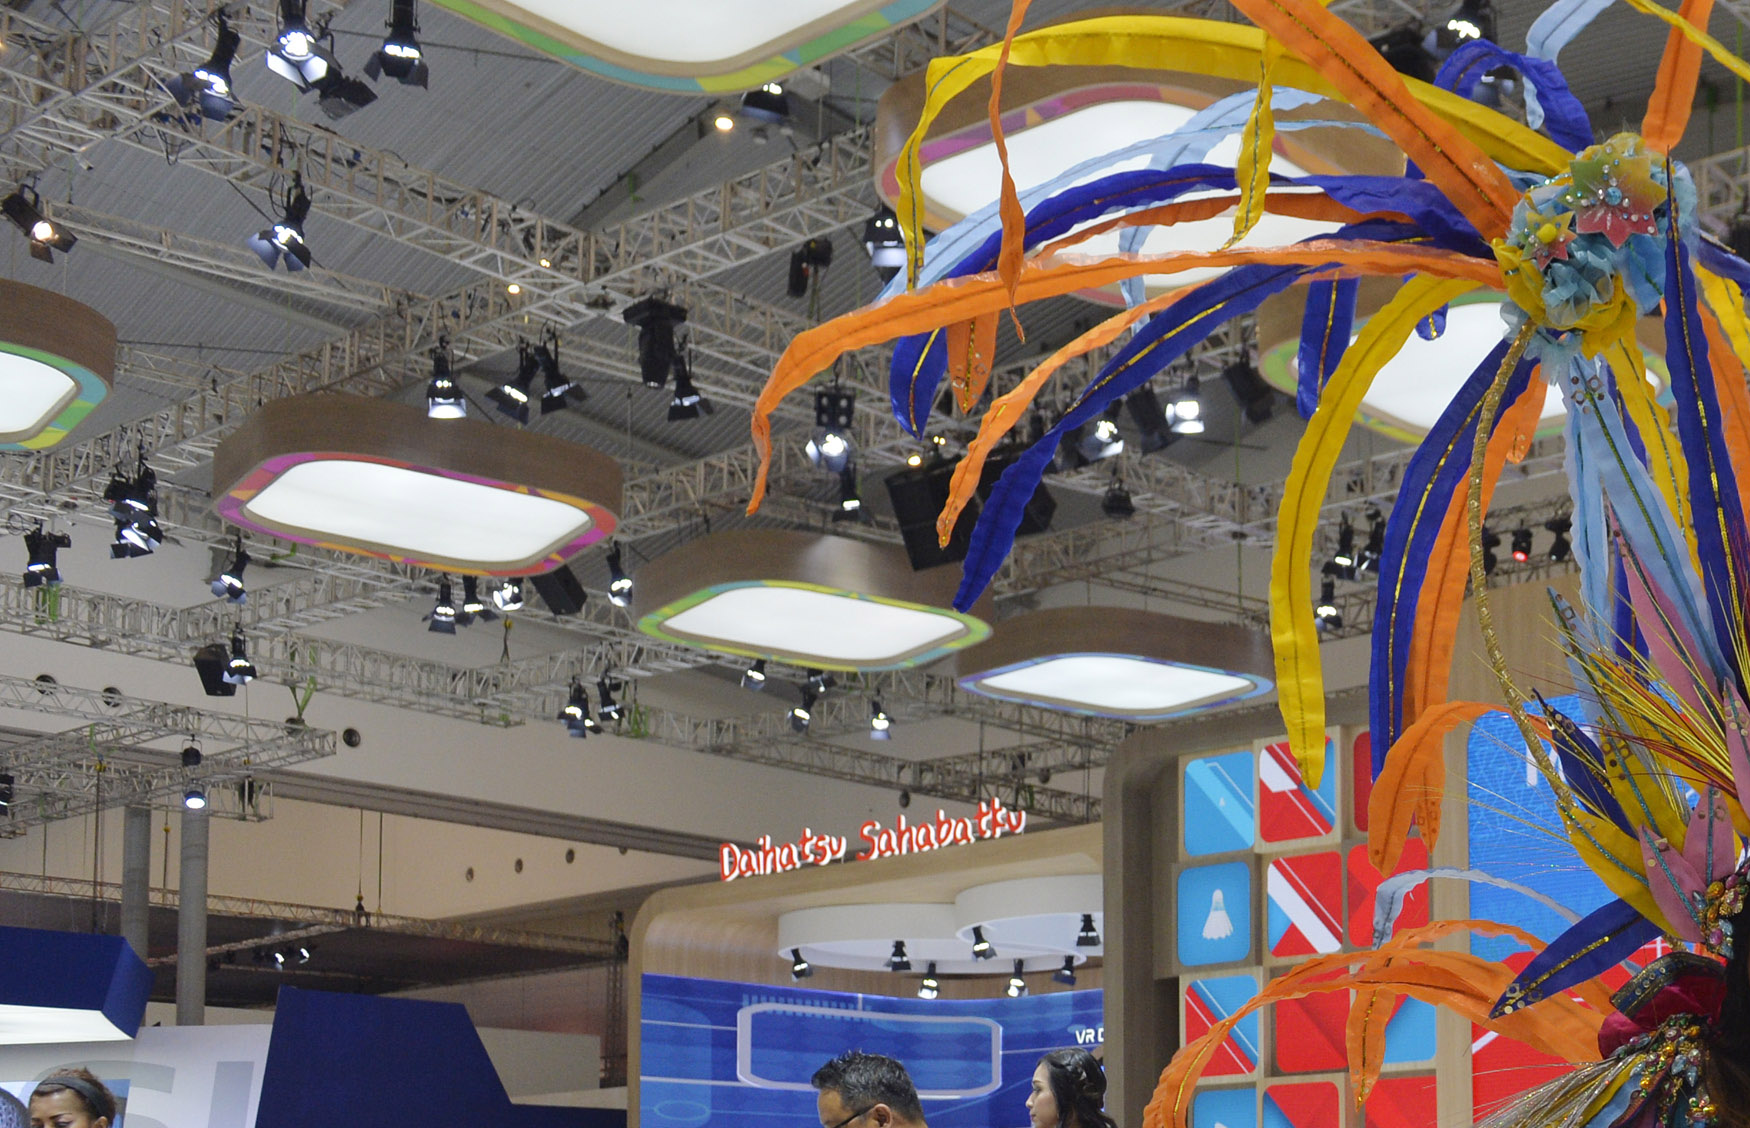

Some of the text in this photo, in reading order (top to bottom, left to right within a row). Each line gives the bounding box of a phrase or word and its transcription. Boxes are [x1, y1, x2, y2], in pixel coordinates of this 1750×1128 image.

[719, 797, 1026, 881] Daihatsu Sahabatku
[1075, 1028, 1095, 1044] VR
